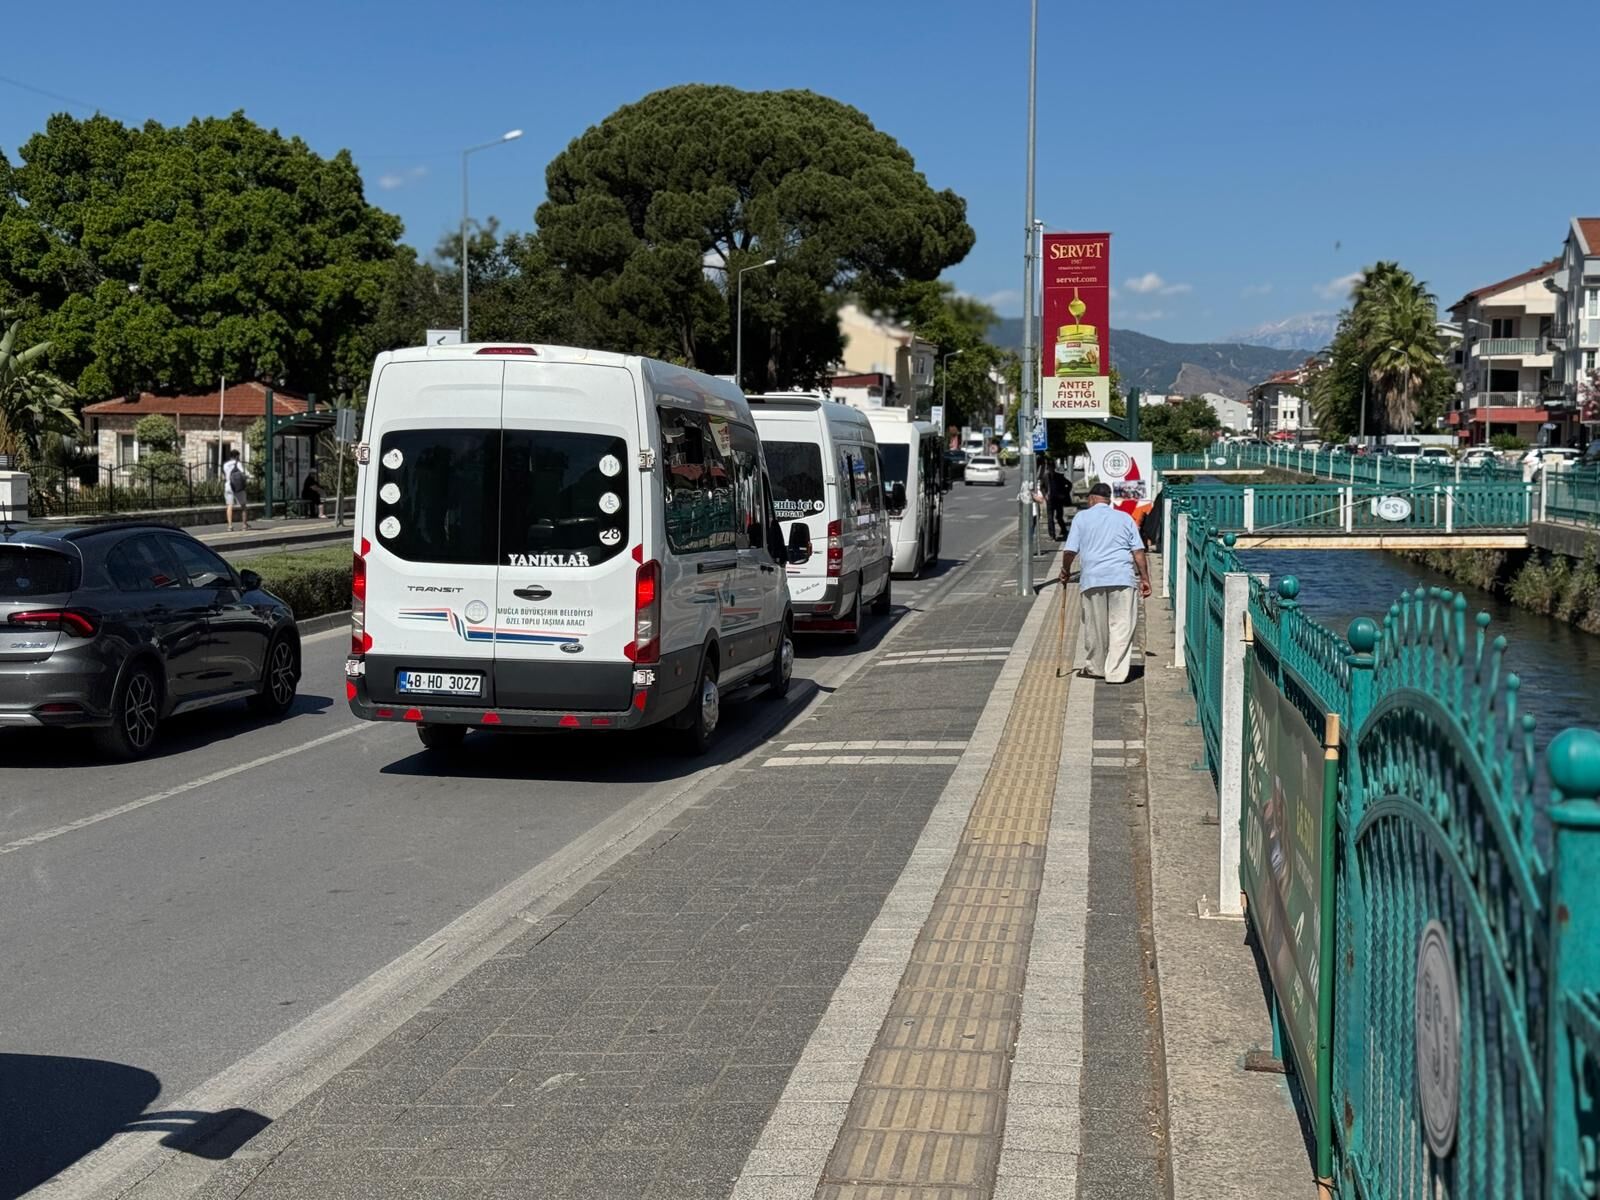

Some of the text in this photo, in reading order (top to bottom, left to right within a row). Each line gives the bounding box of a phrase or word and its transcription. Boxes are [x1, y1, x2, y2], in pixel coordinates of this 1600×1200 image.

[1050, 243, 1104, 259] SERVET
[1059, 381, 1094, 389] ANTEP
[1057, 389, 1096, 399] FISTIĞI
[1052, 400, 1101, 408] KREMASI
[773, 498, 796, 510] EHİR
[602, 529, 621, 541] 28
[508, 553, 590, 567] YANIKLAR
[497, 607, 519, 616] MUĞLA
[560, 608, 594, 617] BELEDİYESİ
[506, 617, 520, 625] ÖZEL
[542, 618, 565, 627] TAŞIMA
[407, 674, 422, 688] 48
[448, 676, 480, 691] 3027
